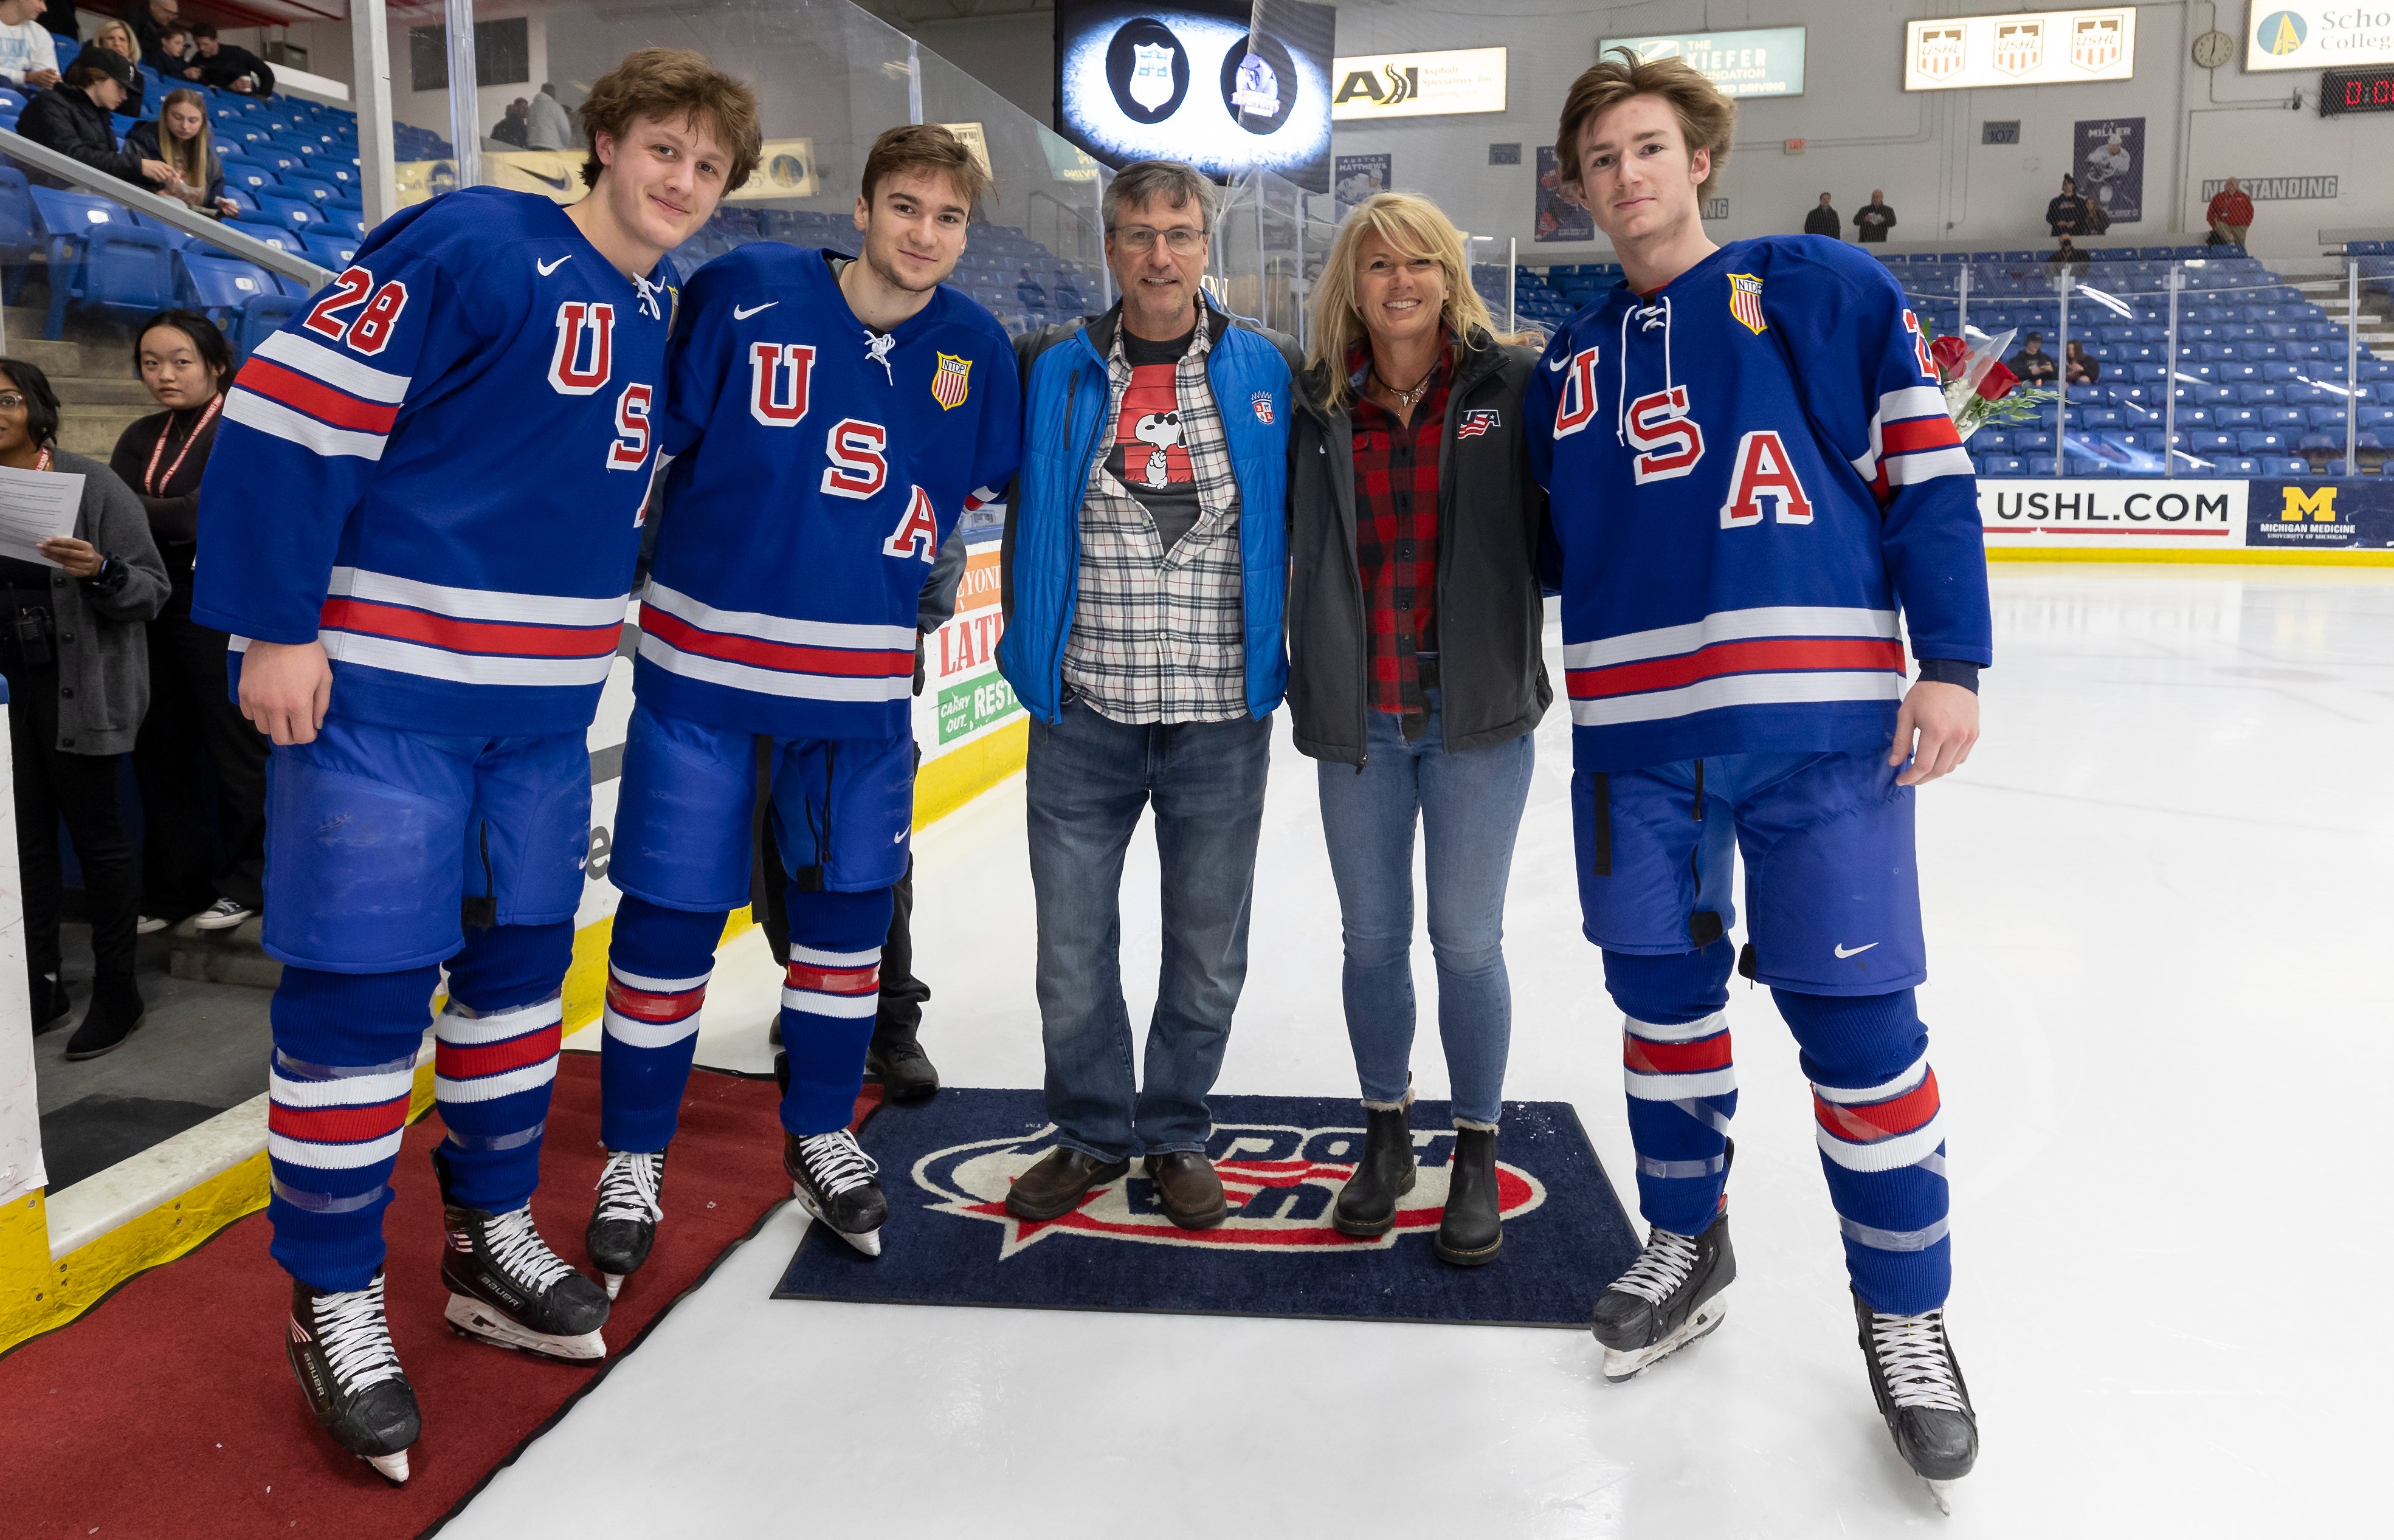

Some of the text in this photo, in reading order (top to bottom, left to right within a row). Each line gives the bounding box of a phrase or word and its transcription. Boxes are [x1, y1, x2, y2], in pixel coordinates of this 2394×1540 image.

[1687, 40, 1712, 50] THE
[1998, 39, 2037, 51] USHL
[2076, 34, 2118, 46] USHL
[2320, 33, 2394, 50] Colleg
[1922, 44, 1960, 55] USHL
[1686, 49, 1767, 70] KIEFER
[1423, 66, 1460, 77] Asphalt
[1334, 63, 1418, 105] ASI
[1738, 81, 1787, 94] DRIVING
[1339, 162, 1388, 171] MATTHEWS
[2239, 177, 2337, 199] STANDING
[1738, 279, 1762, 293] NTDP
[302, 265, 409, 356] 28
[943, 359, 965, 373] NTDP
[1997, 492, 2229, 523] USHL.COM
[2281, 486, 2337, 522] M
[2260, 523, 2356, 534] MICHIGAN MEDICINE
[974, 678, 1018, 720] REST
[480, 1276, 520, 1307] BAUER
[303, 1352, 325, 1397] BAUER
